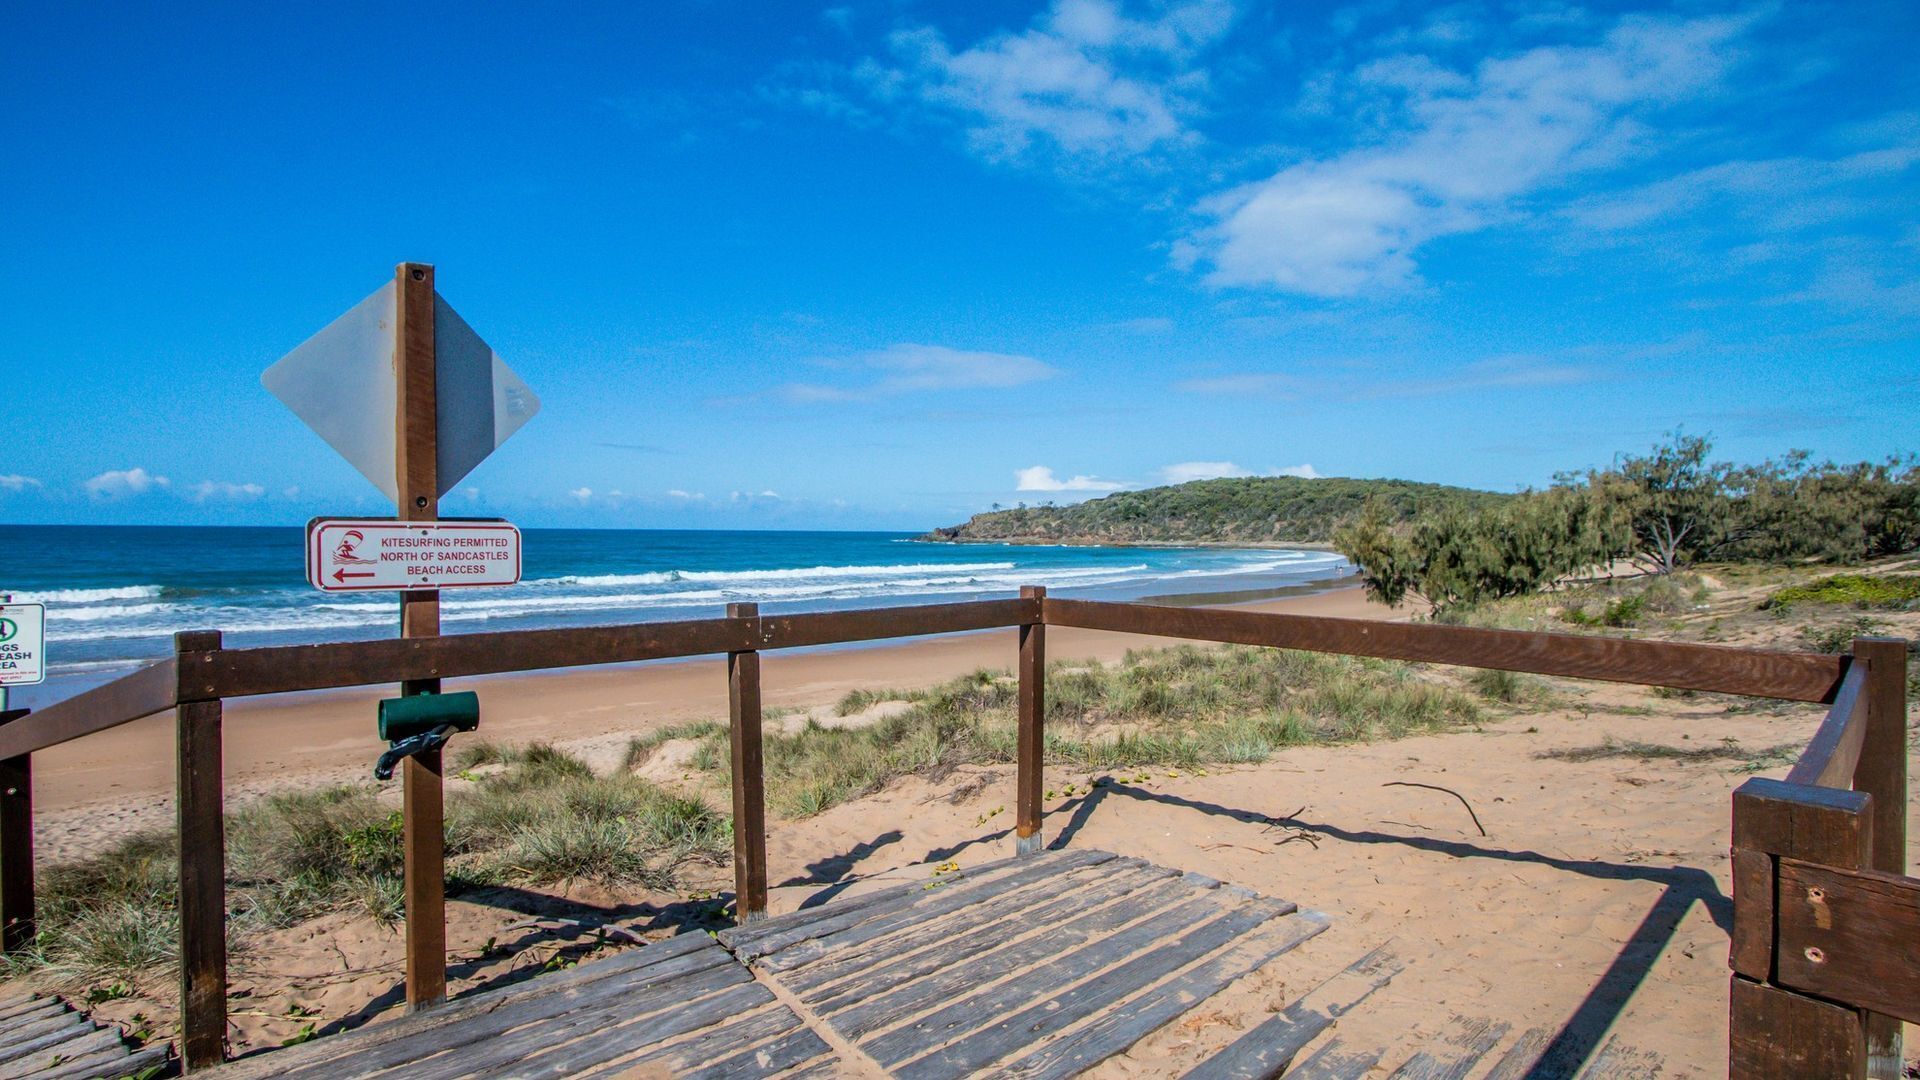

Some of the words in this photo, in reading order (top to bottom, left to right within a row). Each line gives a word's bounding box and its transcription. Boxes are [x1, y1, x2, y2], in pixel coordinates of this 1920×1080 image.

[381, 538, 451, 547] KITESURFING
[453, 538, 508, 547] PERMITTED
[380, 552, 418, 561] NORTH
[420, 552, 435, 561] OF
[437, 551, 509, 560] SANDCASTLES
[407, 565, 443, 575] BEACH
[445, 564, 486, 574] ACCESS
[0, 644, 19, 652] GS
[0, 661, 17, 669] EA
